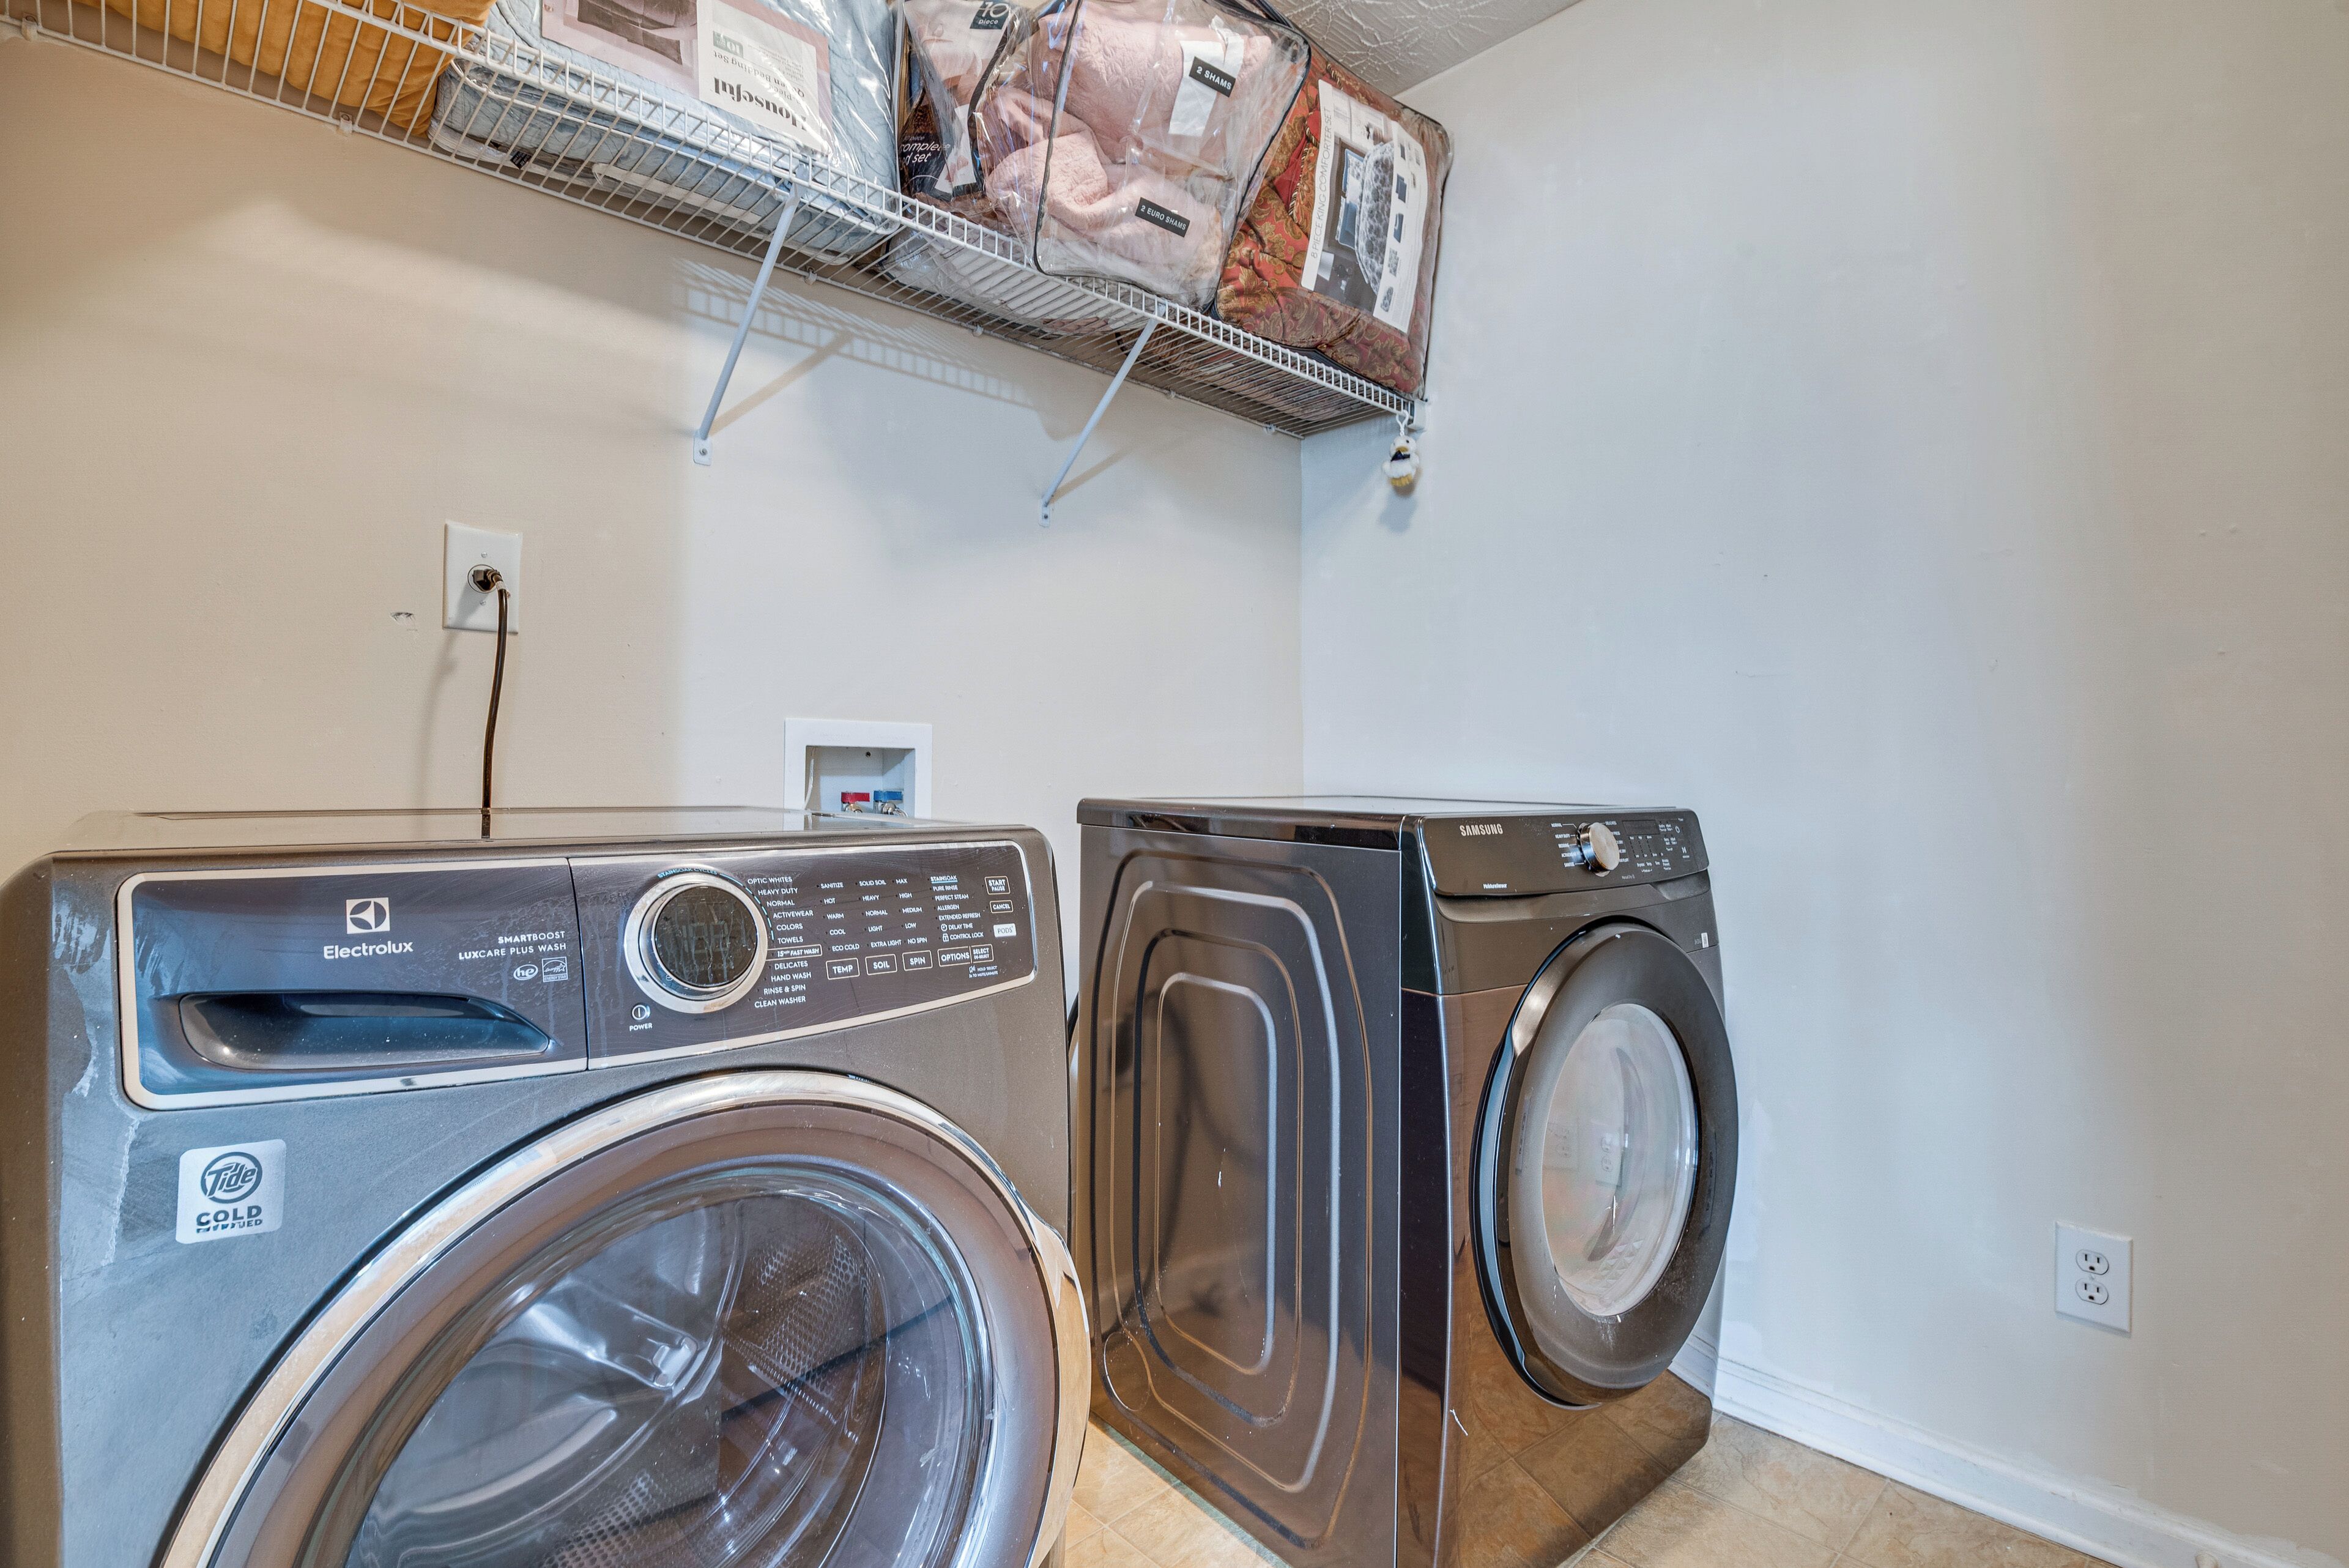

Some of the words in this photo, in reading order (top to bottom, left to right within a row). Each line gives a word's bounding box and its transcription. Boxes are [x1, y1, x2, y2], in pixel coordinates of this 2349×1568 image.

[982, 1, 1009, 18] 10
[714, 50, 730, 64] Set
[732, 57, 771, 83] Bedding
[1196, 65, 1203, 75] 2
[1204, 70, 1232, 91] SHAMS
[1323, 108, 1332, 124] SET
[912, 152, 931, 162] set
[1319, 125, 1332, 192] COMFORTER
[1316, 193, 1327, 221] KING
[1147, 207, 1165, 220] EURO
[1165, 214, 1187, 231] SHAMS
[1313, 222, 1323, 249] PIECE
[1311, 249, 1318, 259] 8
[1460, 823, 1504, 836] SAMSUNG
[657, 868, 693, 879] STAINSOAK
[773, 910, 814, 919] ACTIVEWEAR
[498, 931, 565, 944] SMARTBOOST
[323, 940, 414, 959] Electrolux
[459, 948, 507, 960] LUXCARE
[510, 945, 534, 955] PLUS
[538, 943, 566, 953] WASH
[910, 956, 926, 965] SPIN
[941, 952, 970, 962] OPTIONS
[774, 960, 808, 970] DELICATES
[833, 964, 853, 974] TEMP
[873, 960, 890, 970] SOIL
[516, 966, 535, 978] he
[763, 986, 783, 995] RINSE
[754, 999, 777, 1008] CLEAN
[778, 995, 806, 1005] WASHER
[629, 1022, 653, 1031] POWER
[207, 1162, 256, 1197] Tide
[196, 1205, 262, 1227] COLD
